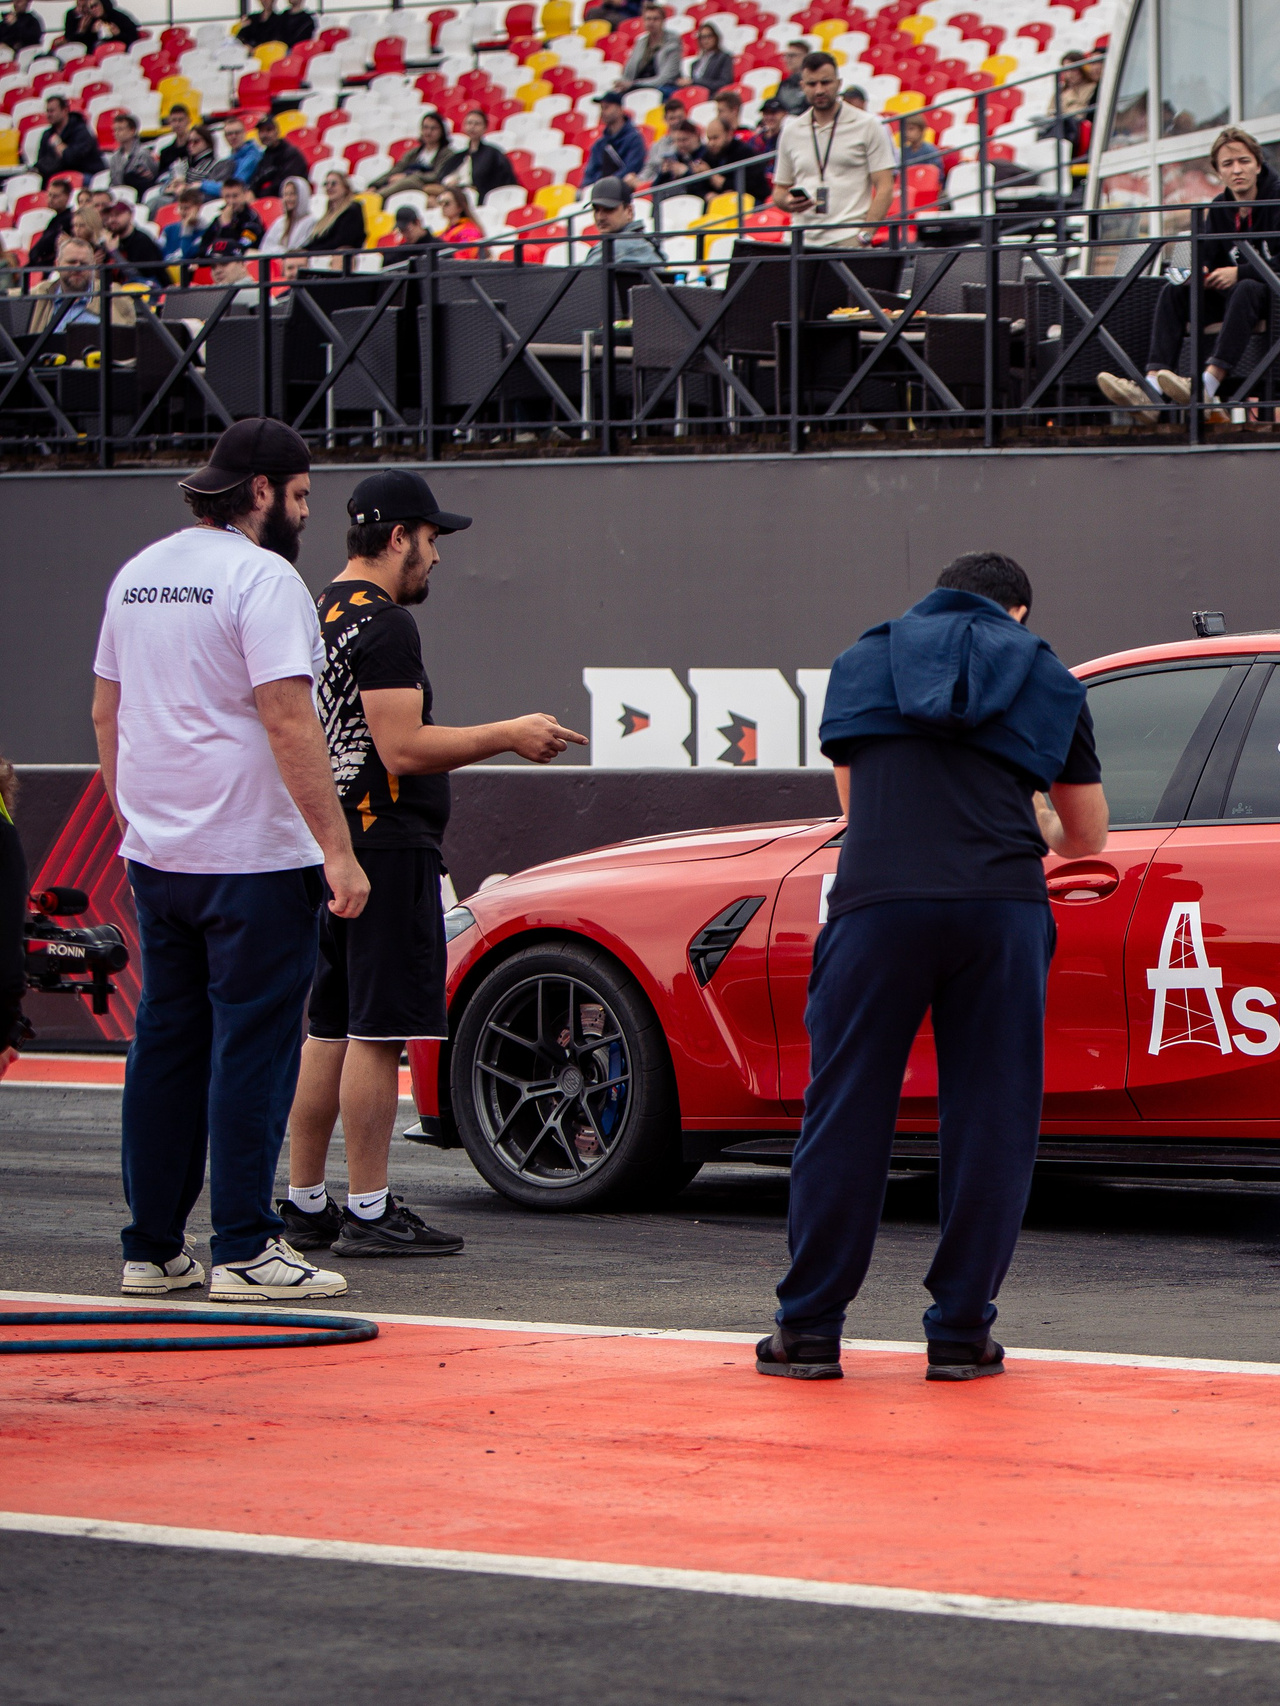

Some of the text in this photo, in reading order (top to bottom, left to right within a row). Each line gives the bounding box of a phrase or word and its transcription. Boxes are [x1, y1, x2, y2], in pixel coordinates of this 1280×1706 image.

[122, 587, 214, 605] ASCO RACING
[47, 943, 86, 958] RONIN
